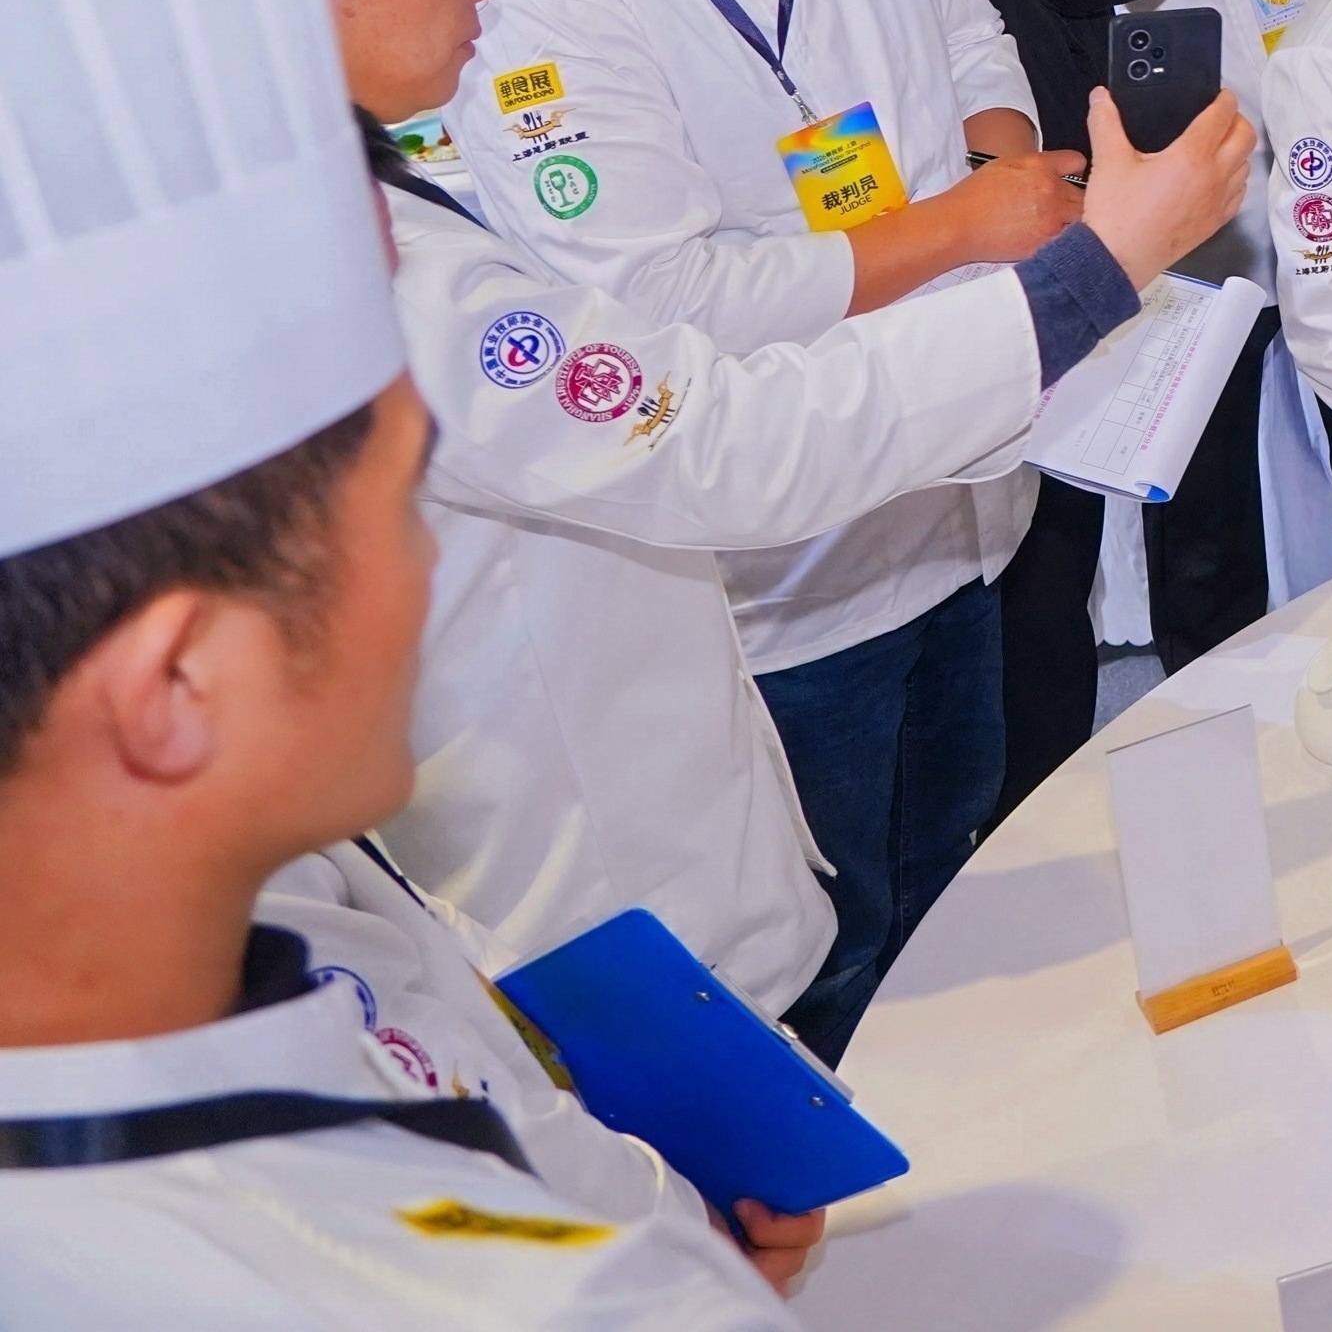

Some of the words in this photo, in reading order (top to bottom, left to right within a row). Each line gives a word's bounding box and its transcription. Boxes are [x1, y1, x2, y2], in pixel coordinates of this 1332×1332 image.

[499, 69, 552, 100] 華食展
[821, 174, 879, 211] 裁判员
[840, 195, 873, 216] JUDGE
